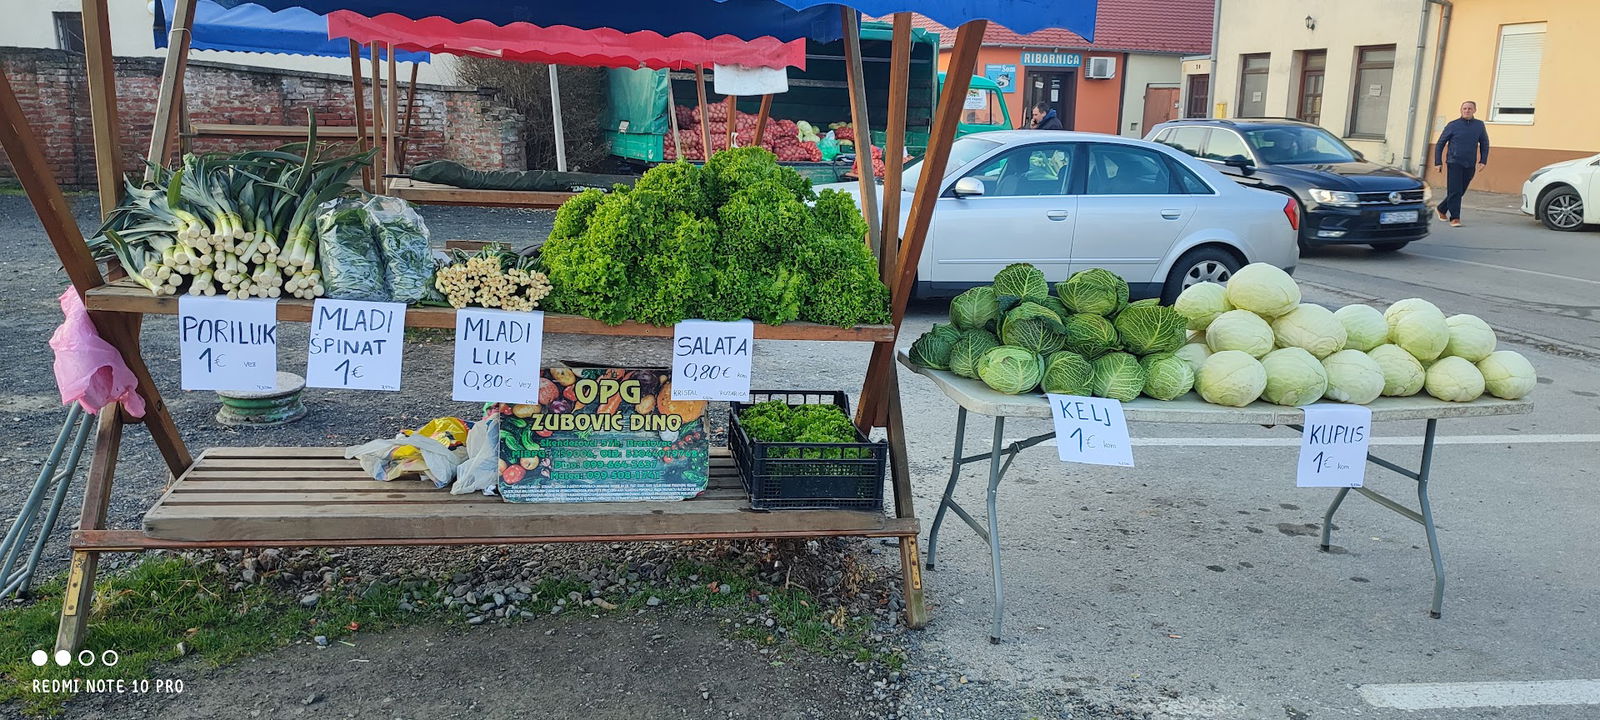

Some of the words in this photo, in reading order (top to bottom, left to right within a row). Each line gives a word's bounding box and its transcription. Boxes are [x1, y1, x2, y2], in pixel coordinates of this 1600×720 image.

[1023, 53, 1080, 65] RIBARNICA
[182, 315, 277, 345] PORILUK
[318, 305, 394, 334] MLADI
[463, 317, 531, 344] MLADI
[309, 333, 388, 356] ŠPINAT
[676, 336, 748, 357] SALATA
[472, 347, 517, 366] LUK
[574, 379, 642, 404] OPG
[673, 389, 698, 397] KRISTAL
[530, 410, 623, 432] ZUBOVIĆ
[629, 414, 683, 432] DINO
[1059, 399, 1112, 427] KELJ
[1309, 424, 1365, 445] KUPUS
